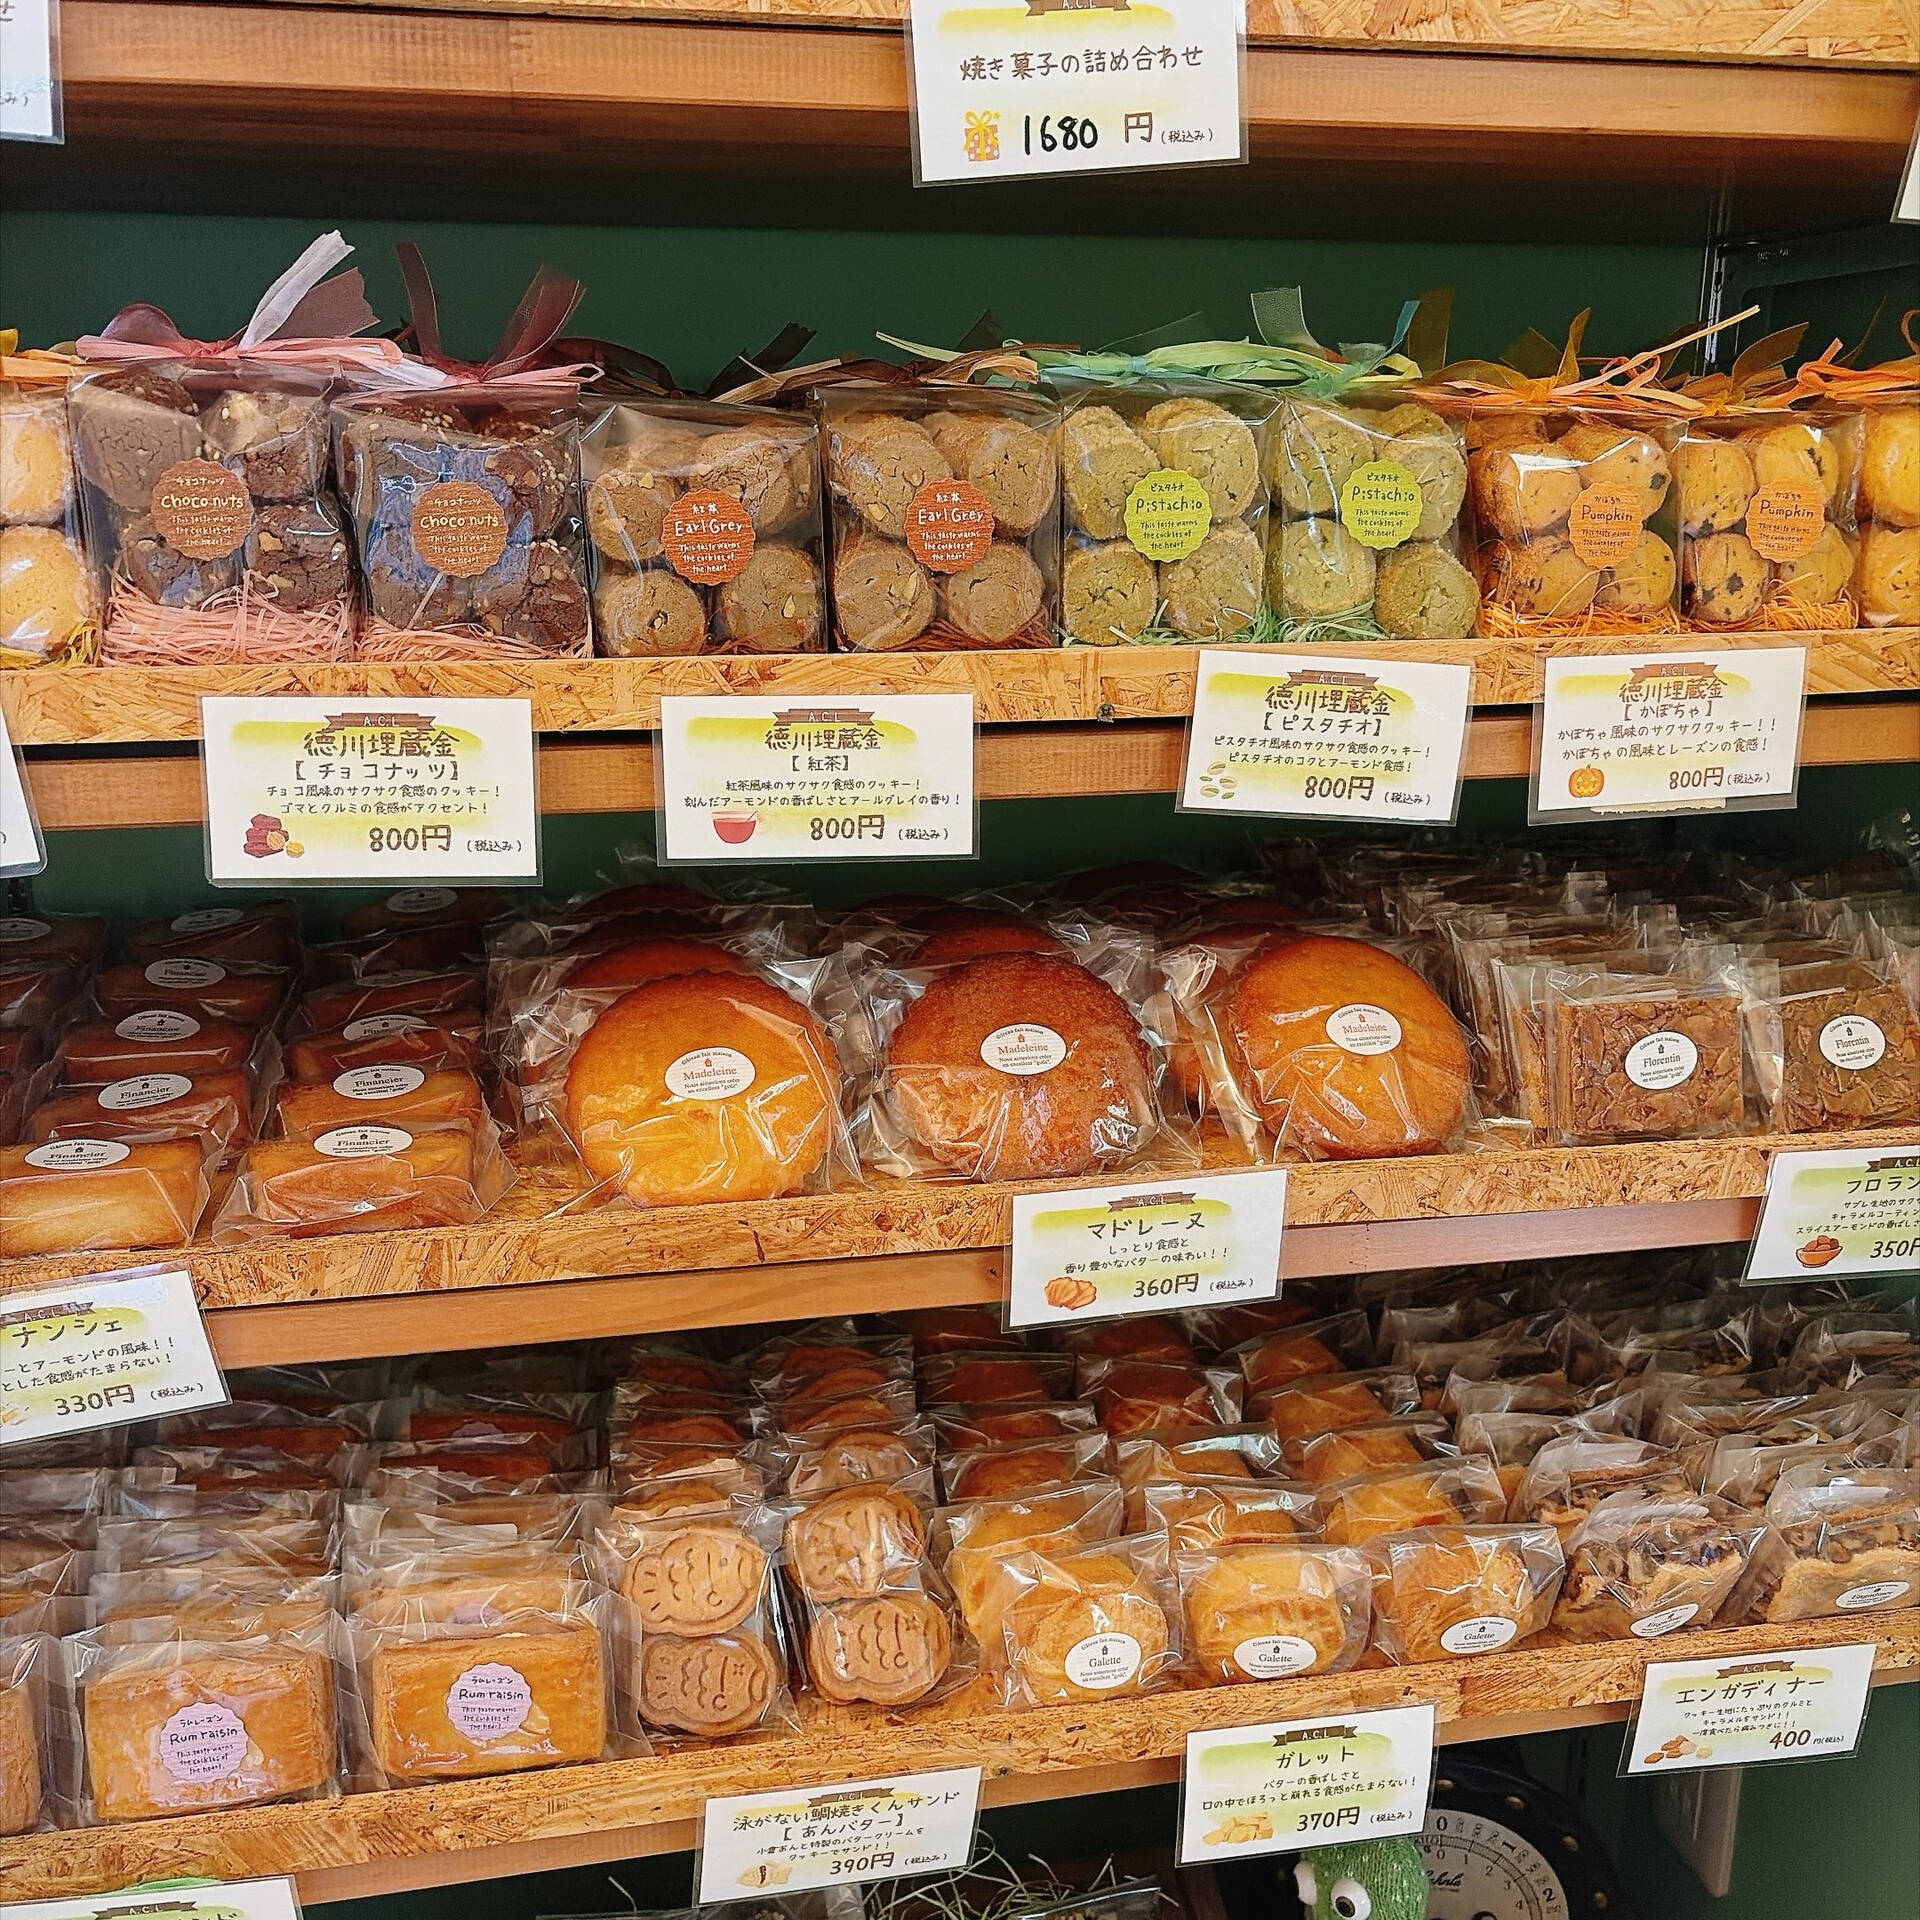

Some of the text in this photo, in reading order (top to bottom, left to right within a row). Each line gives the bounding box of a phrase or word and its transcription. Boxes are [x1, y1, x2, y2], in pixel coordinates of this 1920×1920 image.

[960, 44, 1203, 81] 焼き菓子の詰め合わせ
[1024, 115, 1098, 155] 1680
[1124, 113, 1153, 143] 円
[161, 494, 243, 508] Choco nuts
[1352, 485, 1414, 502] Pistachio
[1136, 496, 1202, 514] Pistachio
[1582, 504, 1632, 524] Pumpkin
[1760, 499, 1814, 519] Pumpkin
[420, 513, 499, 528] Choco nuts
[918, 507, 983, 524] Earl Grey
[675, 518, 742, 537] Earl Grey
[1264, 683, 1396, 716] 徳川埋蔵金
[1619, 678, 1728, 703] 徳川埋蔵金
[304, 729, 460, 760] 徳川埋蔵金
[764, 727, 884, 751] 徳川埋蔵金
[791, 755, 849, 772] 【紅茶】
[1669, 766, 1724, 790] 800円
[1304, 776, 1375, 801] 800円
[809, 814, 885, 841] 800円
[369, 825, 453, 853] 800円
[1342, 1023, 1388, 1035] Madeleine
[997, 1044, 1049, 1055] Madeleine
[1835, 1036, 1870, 1049] Florentin
[1643, 1053, 1681, 1068] Florentin
[354, 1076, 404, 1087] Financier
[683, 1067, 739, 1081] Madeleine
[120, 1086, 172, 1100] Financier
[1847, 1176, 1920, 1194] フロラン
[1087, 1212, 1205, 1240] マドレーヌ
[1108, 1238, 1189, 1255] しっとり食感と
[1132, 1272, 1200, 1299] 360円
[54, 1384, 135, 1416] 330円
[1464, 1633, 1495, 1641] Galette
[1089, 1657, 1122, 1668] Galette
[1258, 1653, 1293, 1663] Galette
[459, 1689, 524, 1700] Rum raisin
[1676, 1677, 1824, 1704] エンガディナー
[170, 1728, 238, 1746] Rum raisin
[1769, 1730, 1811, 1750] 400
[1276, 1745, 1354, 1768] ガレット
[1297, 1806, 1360, 1831] 370円
[1436, 1816, 1447, 1831] 0
[829, 1852, 894, 1876] 390円
[1542, 1888, 1556, 1903] 2
